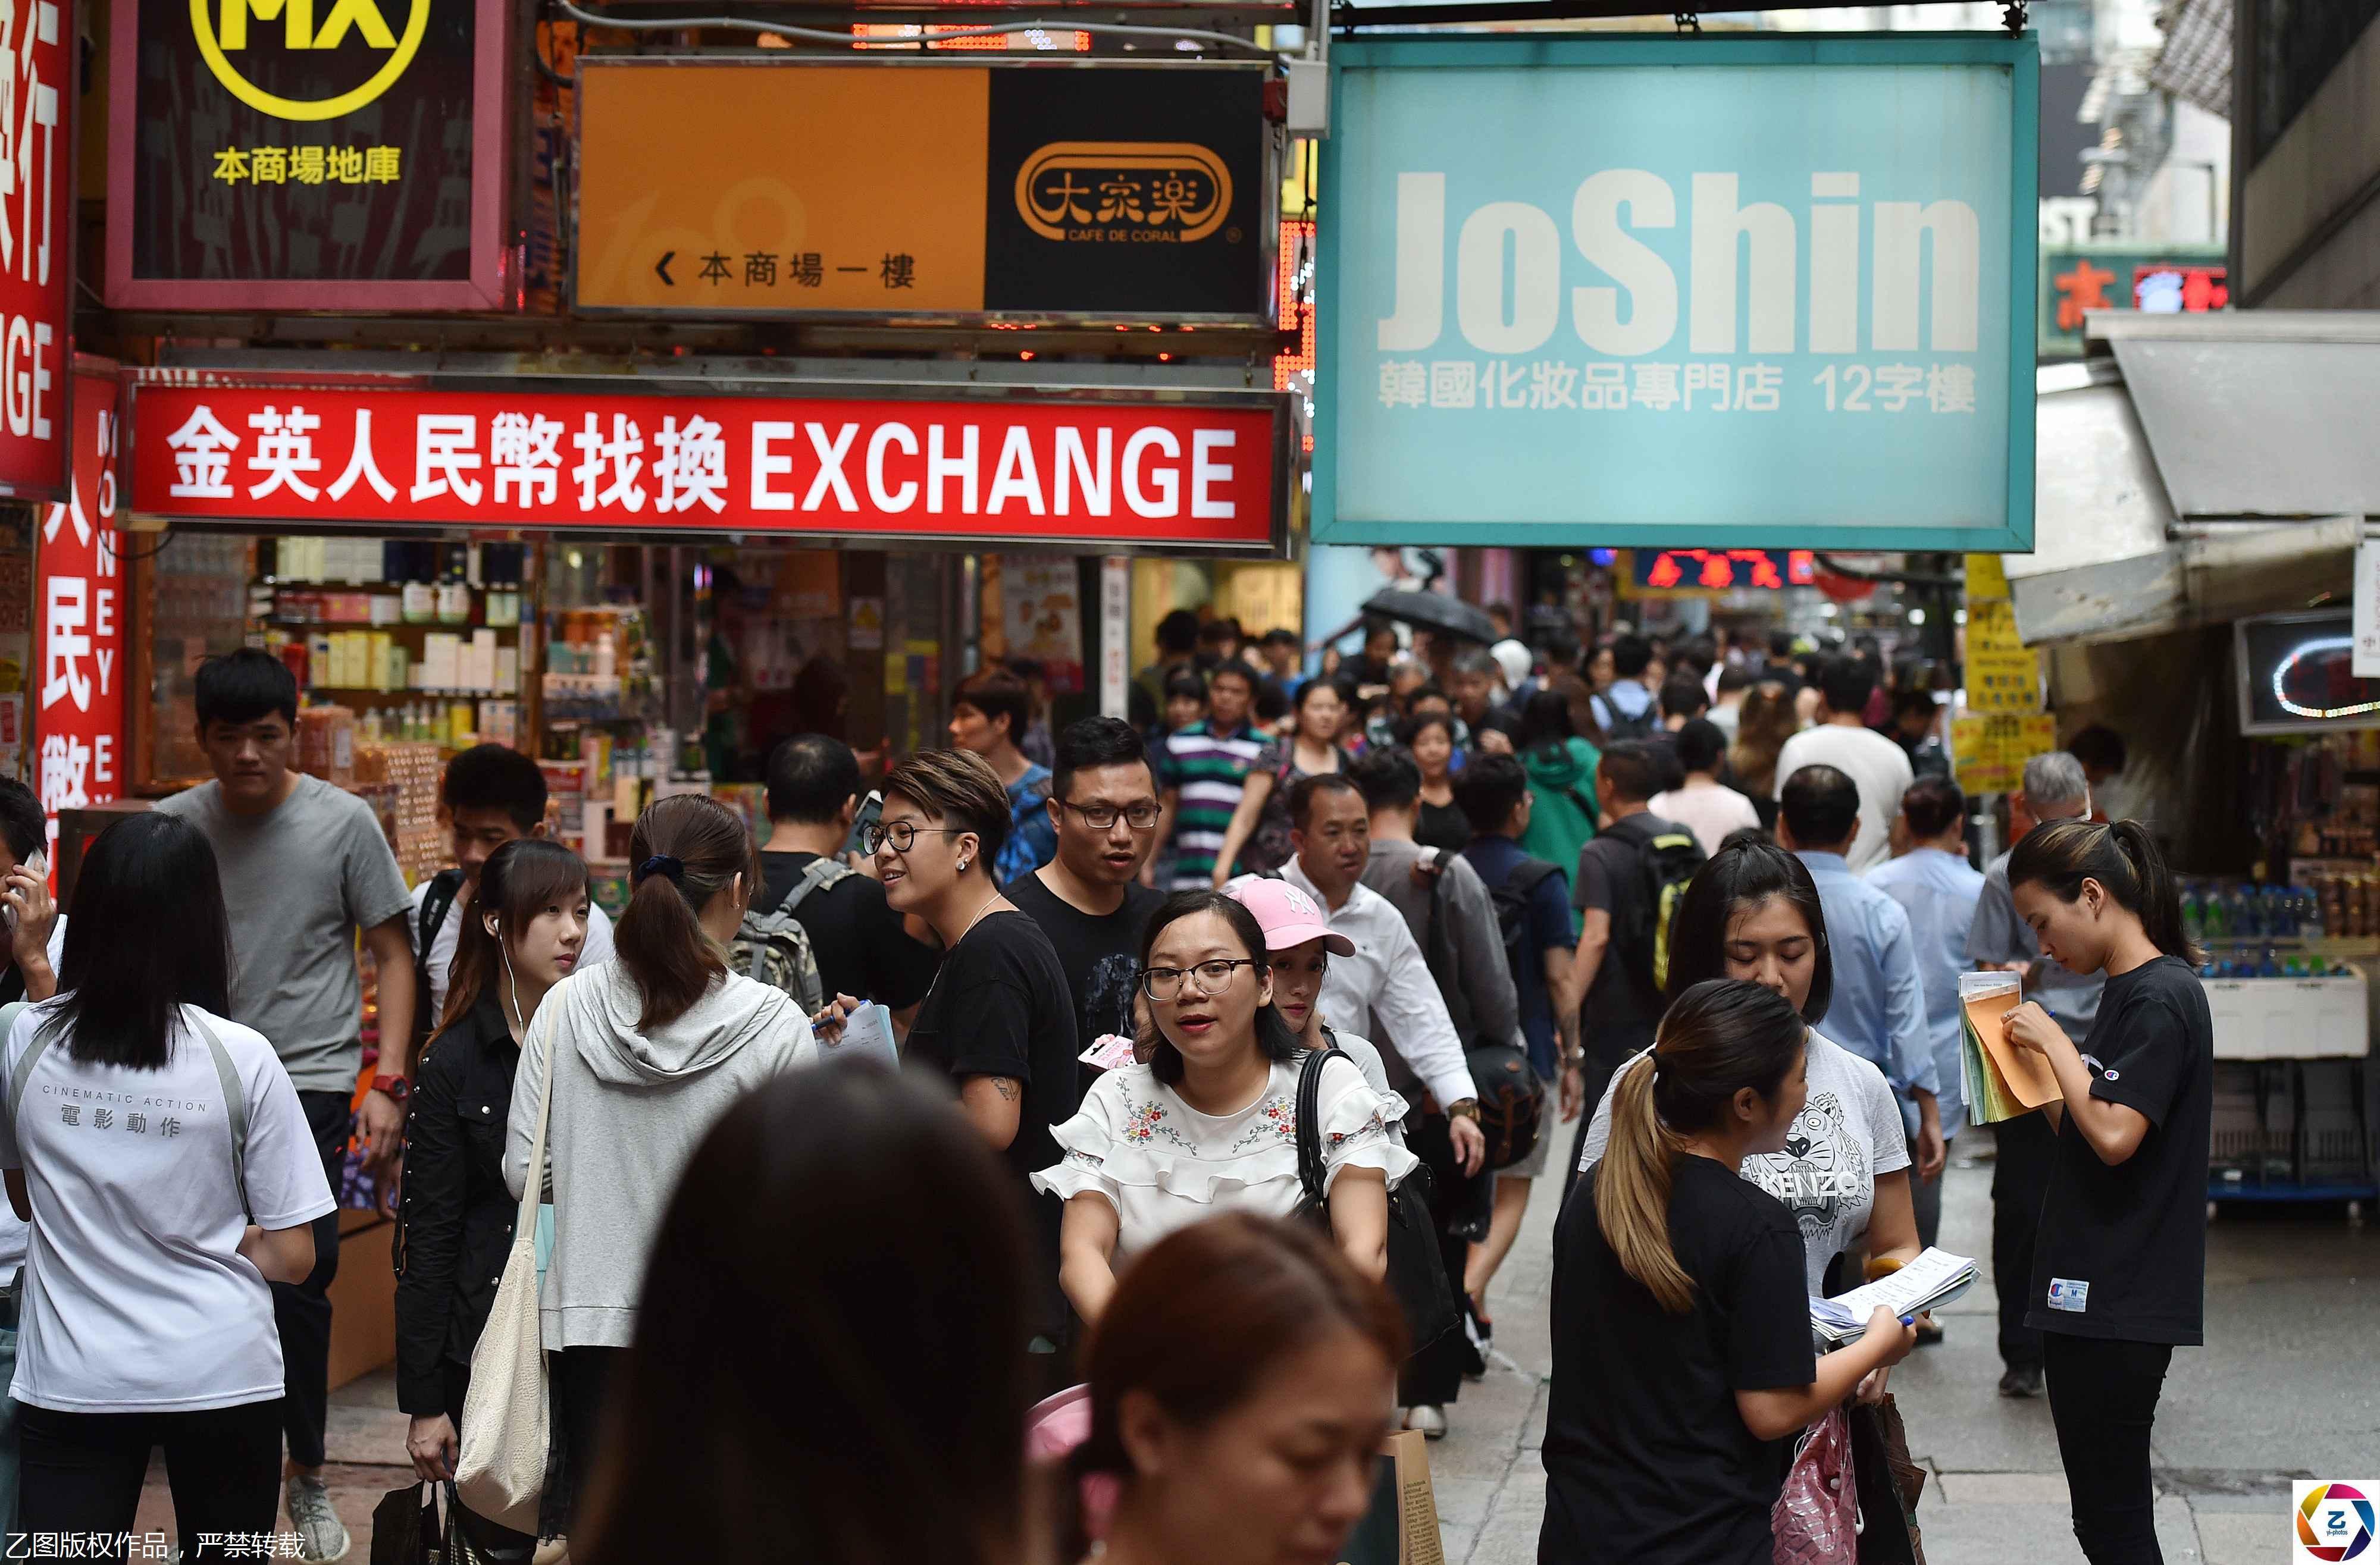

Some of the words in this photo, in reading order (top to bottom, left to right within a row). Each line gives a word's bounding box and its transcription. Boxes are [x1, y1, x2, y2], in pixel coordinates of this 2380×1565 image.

[212, 146, 402, 186] 本商場地庫
[1108, 229, 1128, 242] DE
[1130, 230, 1179, 243] CORAL
[697, 251, 916, 289] 本商場一樓
[1377, 168, 1981, 357] JoShin
[0, 312, 53, 441] GE
[1377, 360, 1784, 412] 韓國化妝品專門店
[1812, 363, 1977, 414] 12字樓
[166, 404, 730, 515] 金英人民幣找換
[750, 421, 1236, 519] EXCHANGE
[42, 1084, 133, 1103] CINEMATIC
[143, 1097, 206, 1112] ACTION
[61, 1104, 181, 1138] 電影動作
[1759, 1171, 1858, 1199] KENZO
